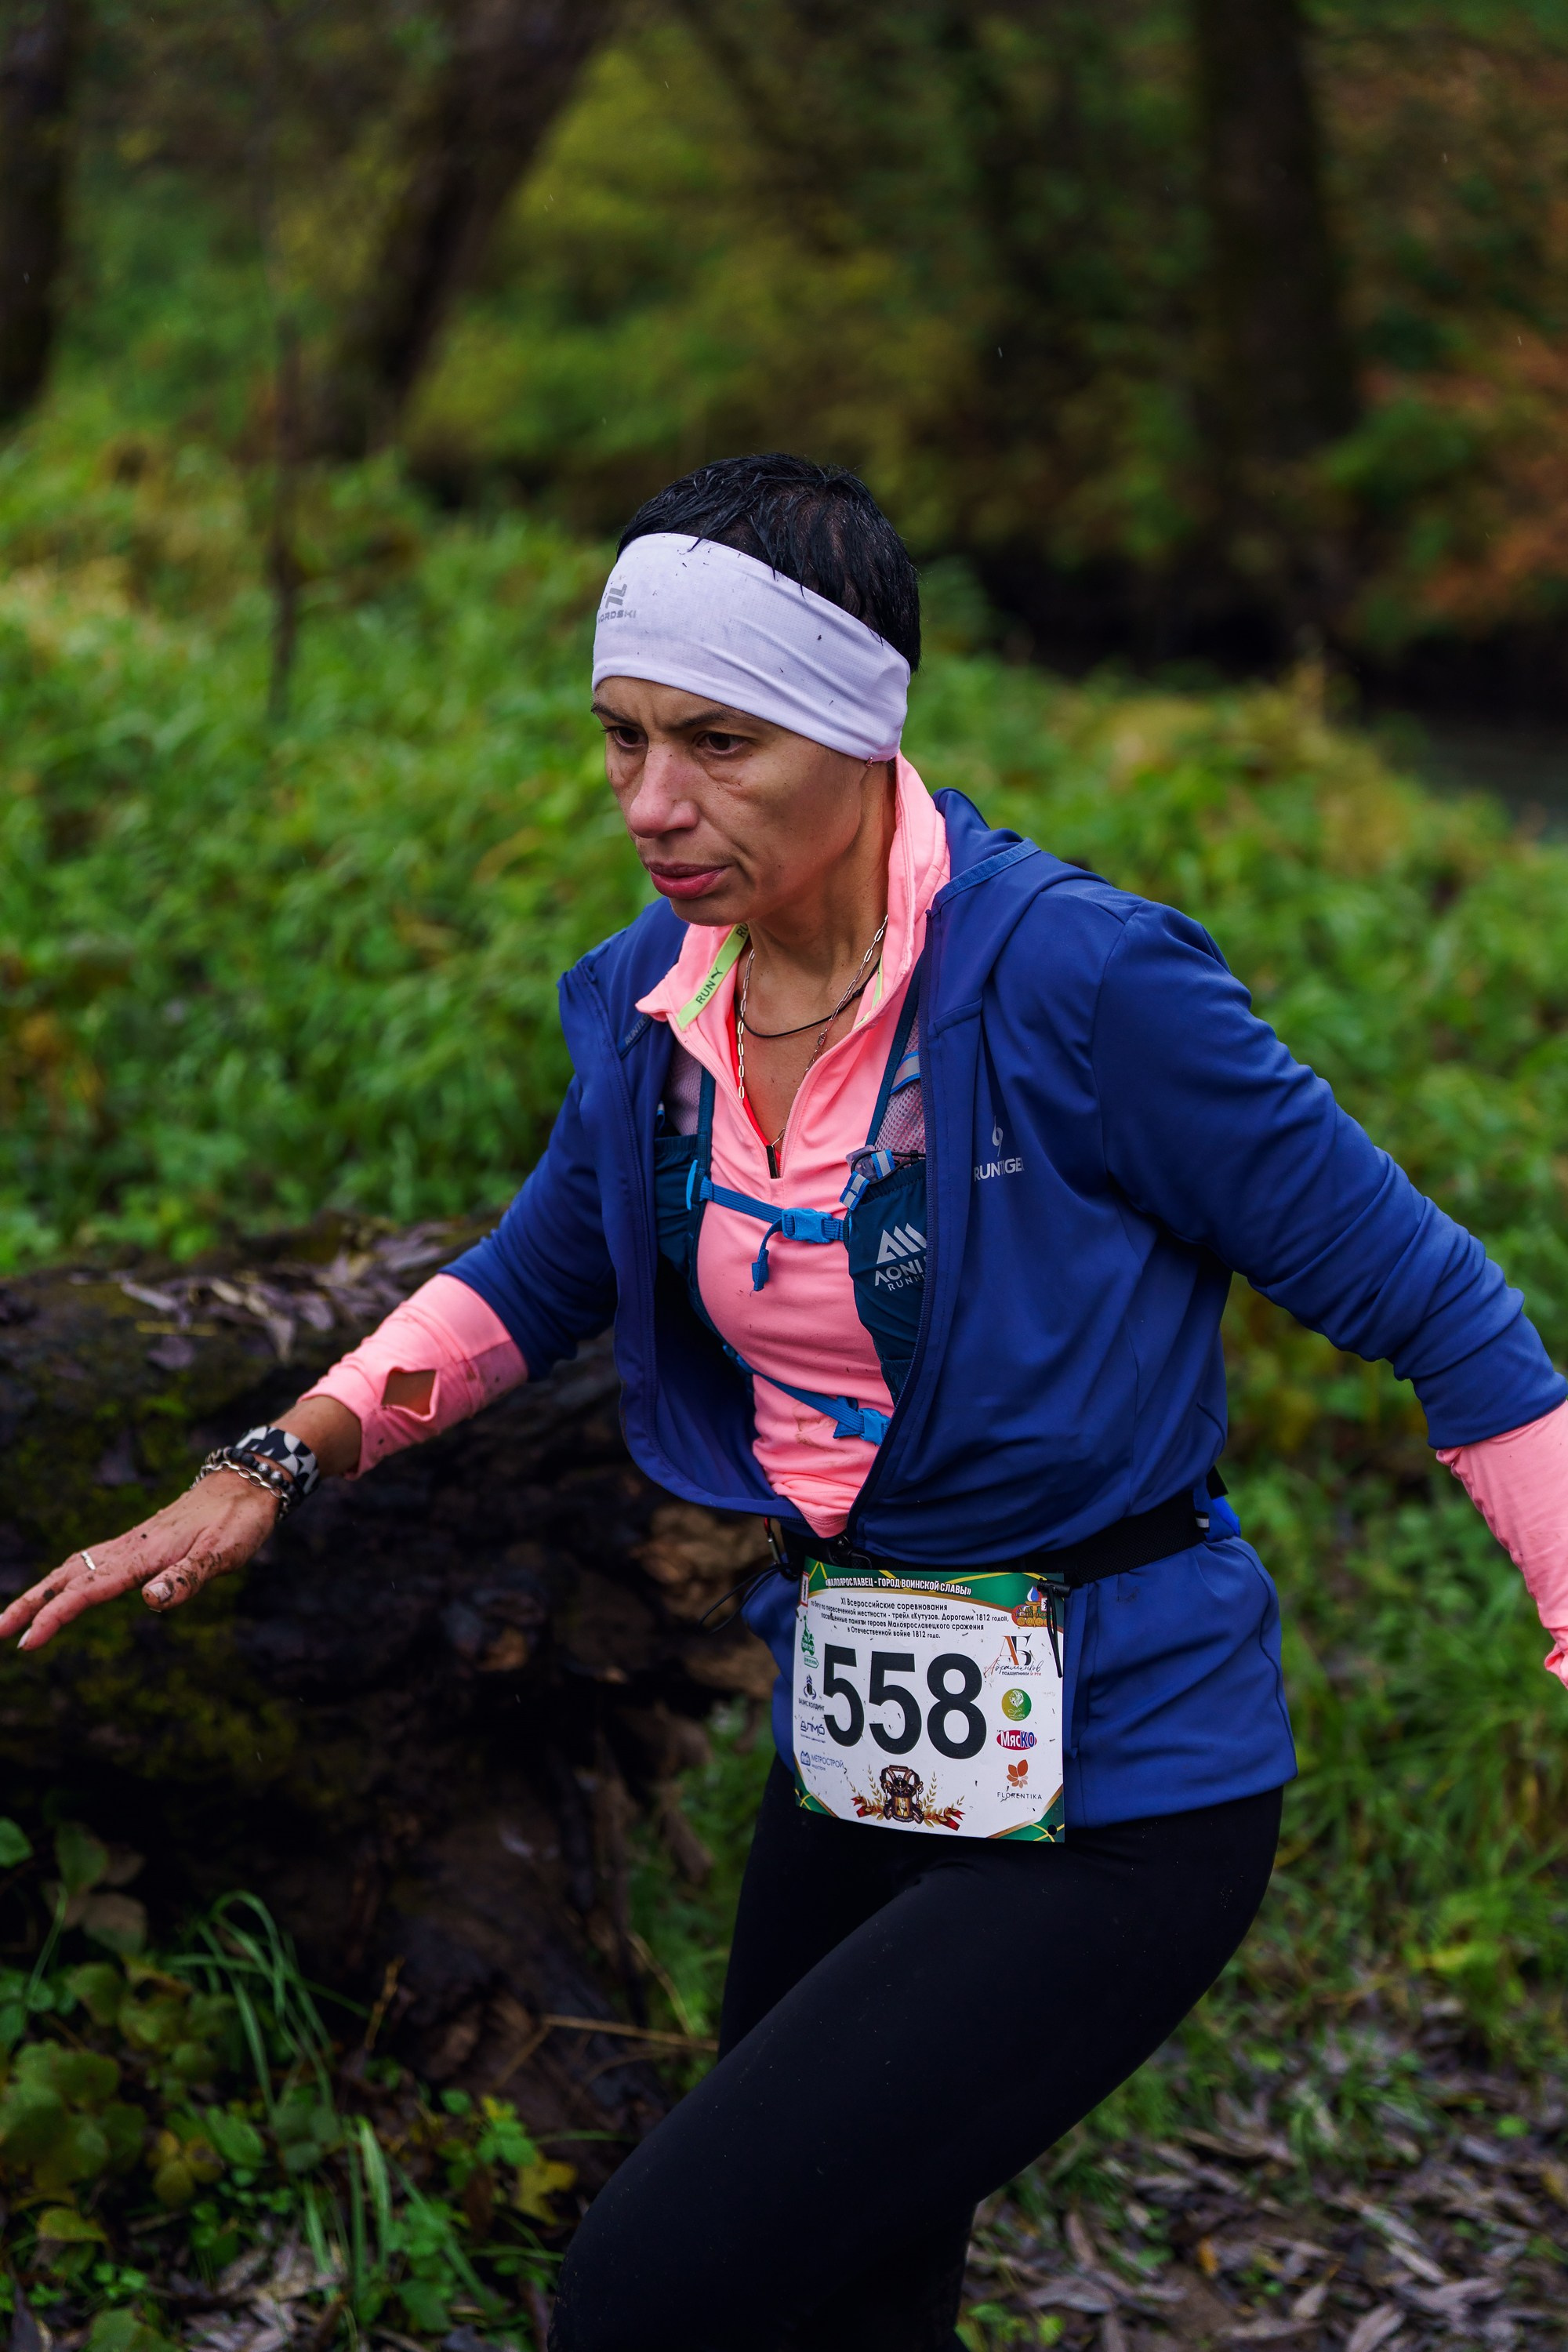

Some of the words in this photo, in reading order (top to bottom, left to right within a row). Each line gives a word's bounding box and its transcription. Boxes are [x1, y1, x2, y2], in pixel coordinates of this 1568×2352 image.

[695, 982, 716, 1004] RUN
[874, 1256, 927, 1287] AONI
[877, 1577, 900, 1588] ГОРОД
[901, 1579, 939, 1591] ВОИНСКОЙ
[940, 1583, 971, 1595] СЛАВЫ»
[847, 1598, 895, 1610] Всероссийские
[897, 1602, 948, 1611] соревнования
[826, 1605, 856, 1616] пересеченной
[892, 1612, 909, 1621] трейл
[851, 1627, 892, 1636] Отечественной
[887, 1621, 950, 1630] Малоярославецкого
[823, 1643, 987, 1760] 558
[811, 1754, 844, 1769] МЕТРОСТРОЙ
[997, 1791, 1043, 1800] FLORENTIKA
